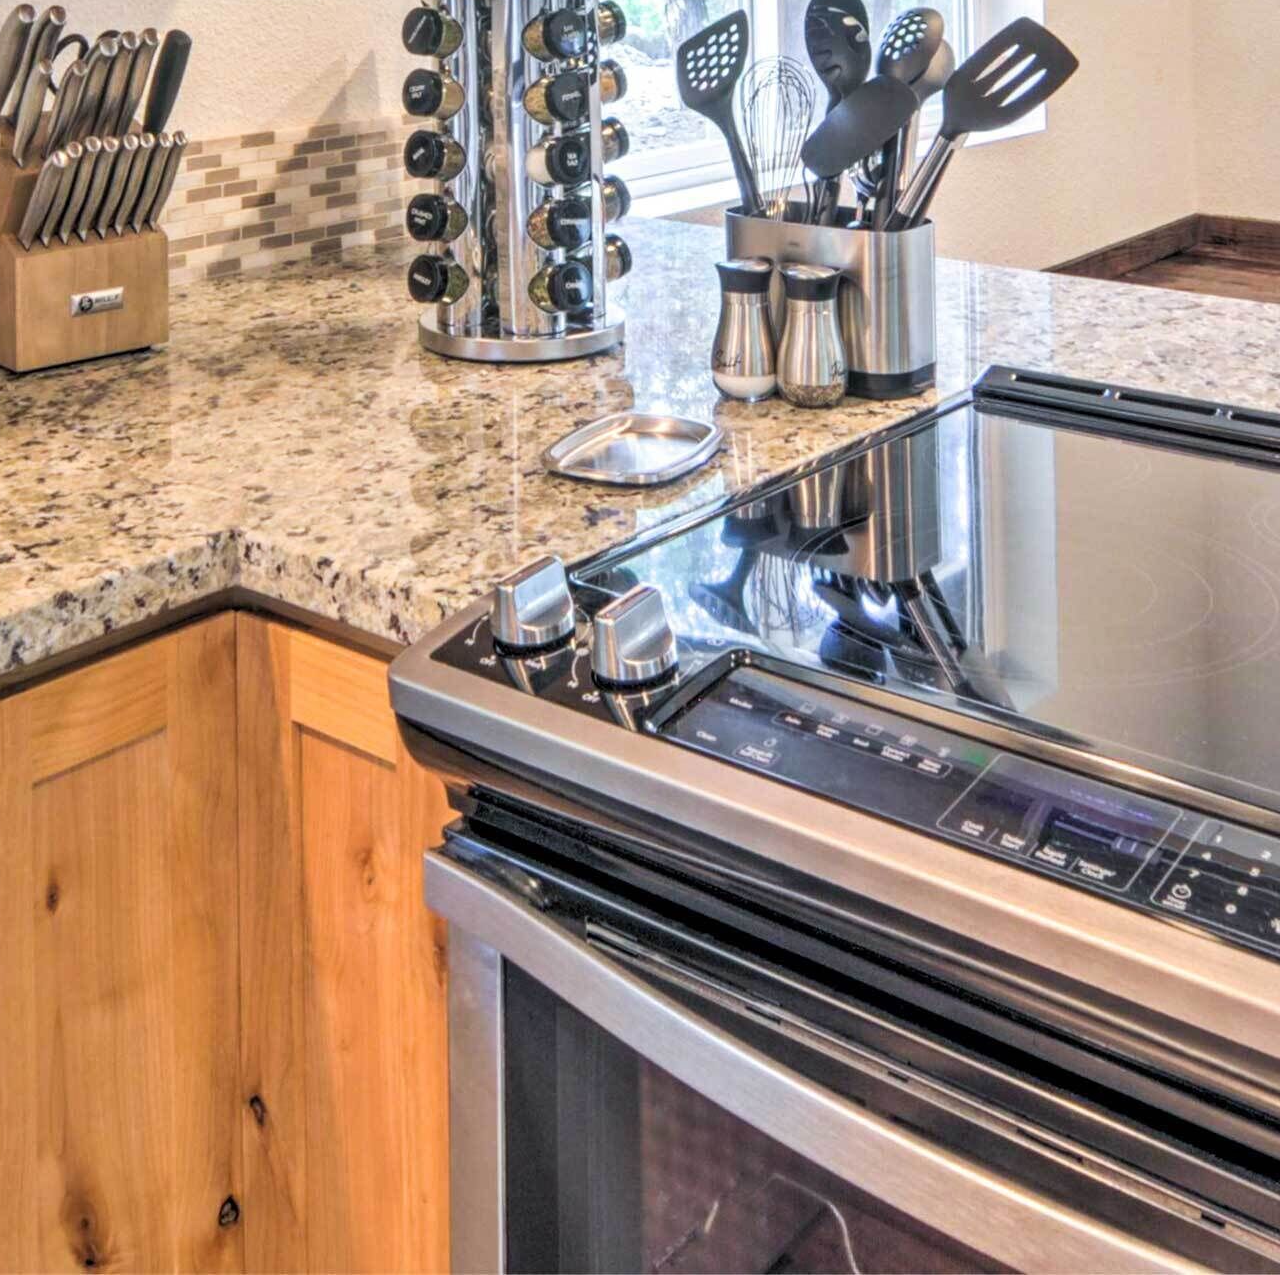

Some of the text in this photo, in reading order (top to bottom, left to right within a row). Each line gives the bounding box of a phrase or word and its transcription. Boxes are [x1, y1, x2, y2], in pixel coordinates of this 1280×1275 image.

[567, 159, 578, 167] SALT
[1201, 851, 1212, 861] 4
[1260, 850, 1272, 861] 2
[1189, 869, 1200, 879] 7
[1249, 867, 1261, 877] 5
[1237, 886, 1248, 896] 8
[1225, 903, 1237, 915] 0
